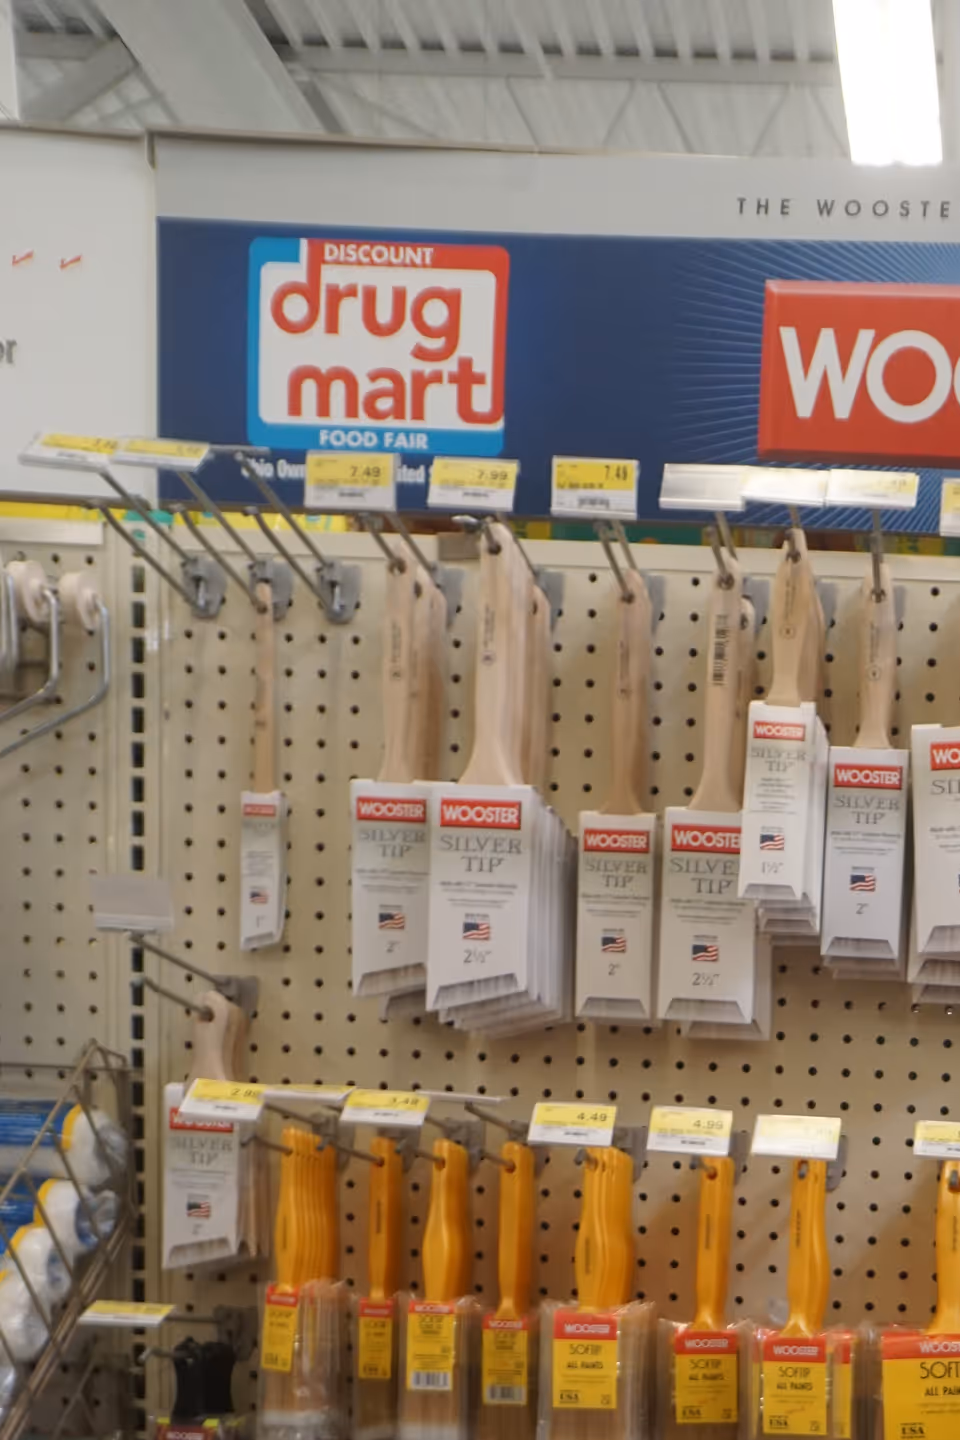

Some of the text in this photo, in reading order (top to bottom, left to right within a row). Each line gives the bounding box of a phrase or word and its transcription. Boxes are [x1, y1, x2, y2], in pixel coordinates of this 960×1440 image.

[737, 198, 792, 216] THE
[324, 244, 433, 265] DISCOUNT
[271, 244, 462, 362] drug
[287, 356, 500, 424] mart
[320, 430, 429, 450] FOOD FAIR
[836, 768, 901, 785] WOOSTER
[359, 800, 424, 818] WOOSTER
[833, 795, 901, 811] SILVER
[442, 803, 520, 825] WOOSTER
[851, 811, 886, 825] TIP
[360, 828, 425, 843] SILVER
[585, 832, 647, 849] WOOSTER
[673, 829, 741, 849] WOOSTE
[379, 844, 412, 858] TIP
[440, 835, 522, 855] SILVER
[462, 856, 505, 873] TIP
[585, 859, 647, 874] SILVER
[669, 856, 739, 876] SILVE
[601, 875, 633, 888] TIP
[690, 877, 733, 895] TIP
[924, 1385, 939, 1396] ALL
